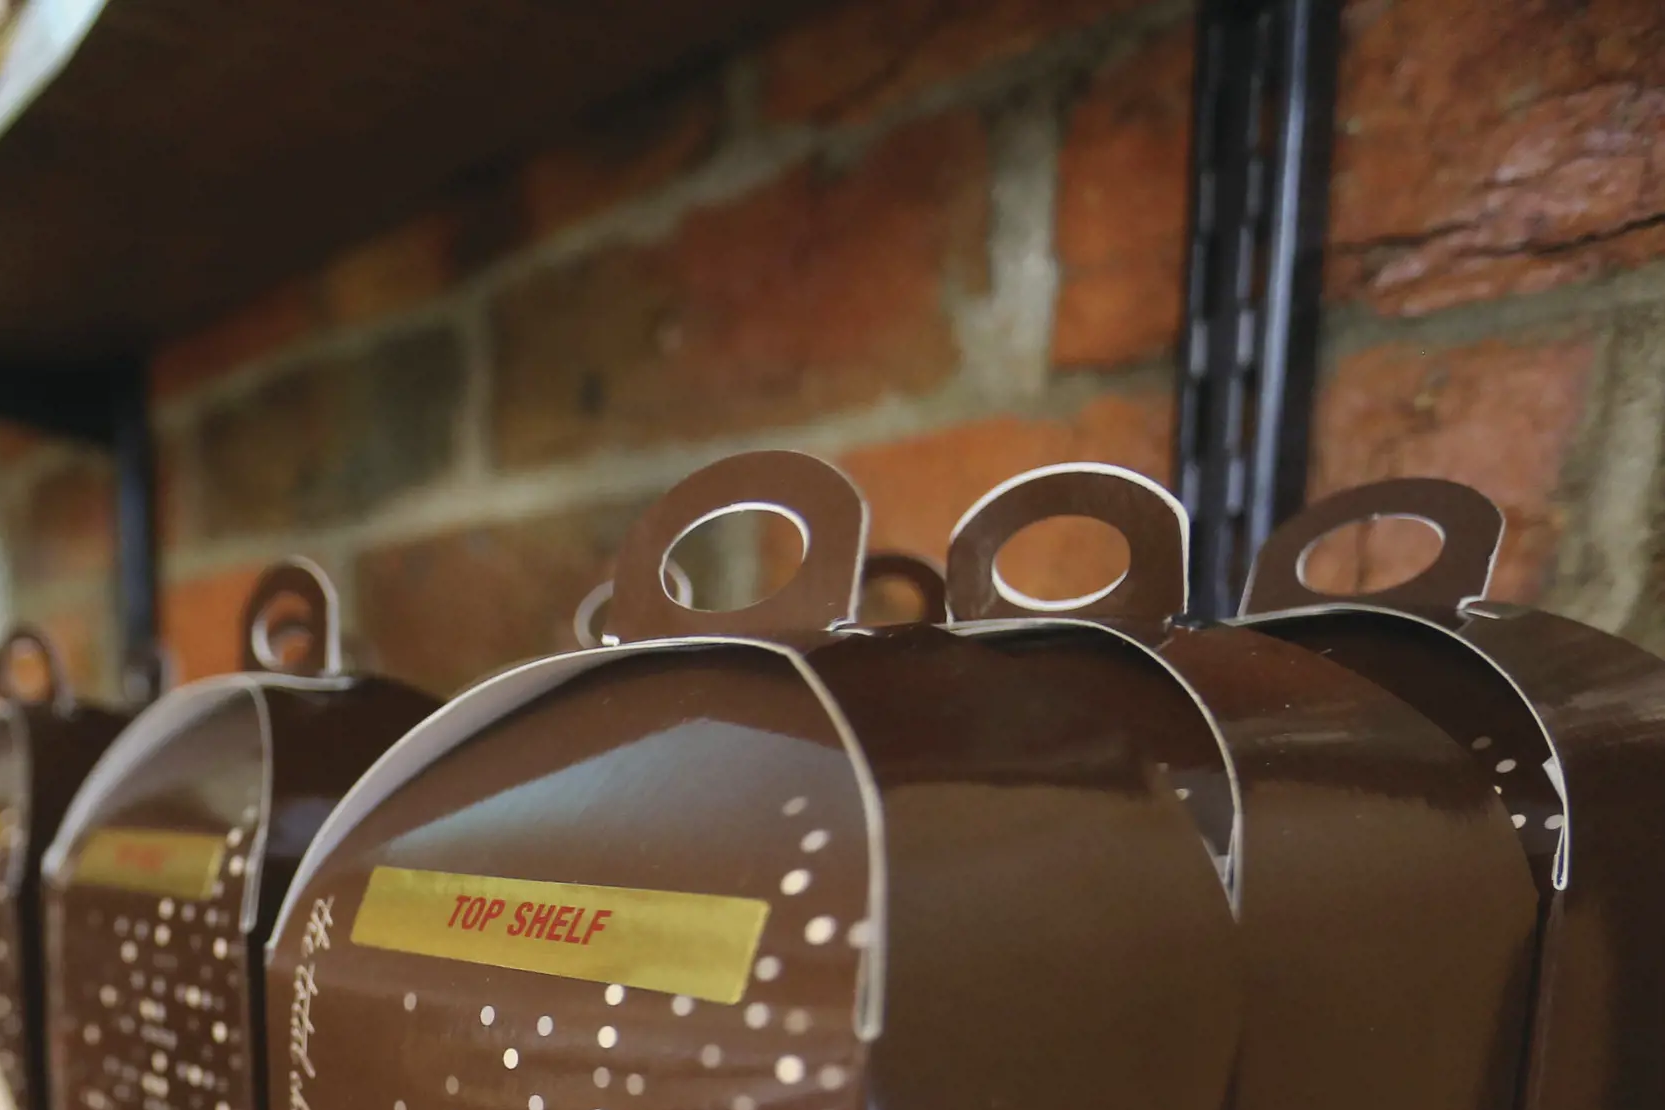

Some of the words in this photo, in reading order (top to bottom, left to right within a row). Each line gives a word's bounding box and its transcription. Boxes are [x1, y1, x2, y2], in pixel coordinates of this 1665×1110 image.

[448, 894, 506, 931] TOP
[507, 901, 613, 945] SHELF
[289, 961, 317, 1078] total
